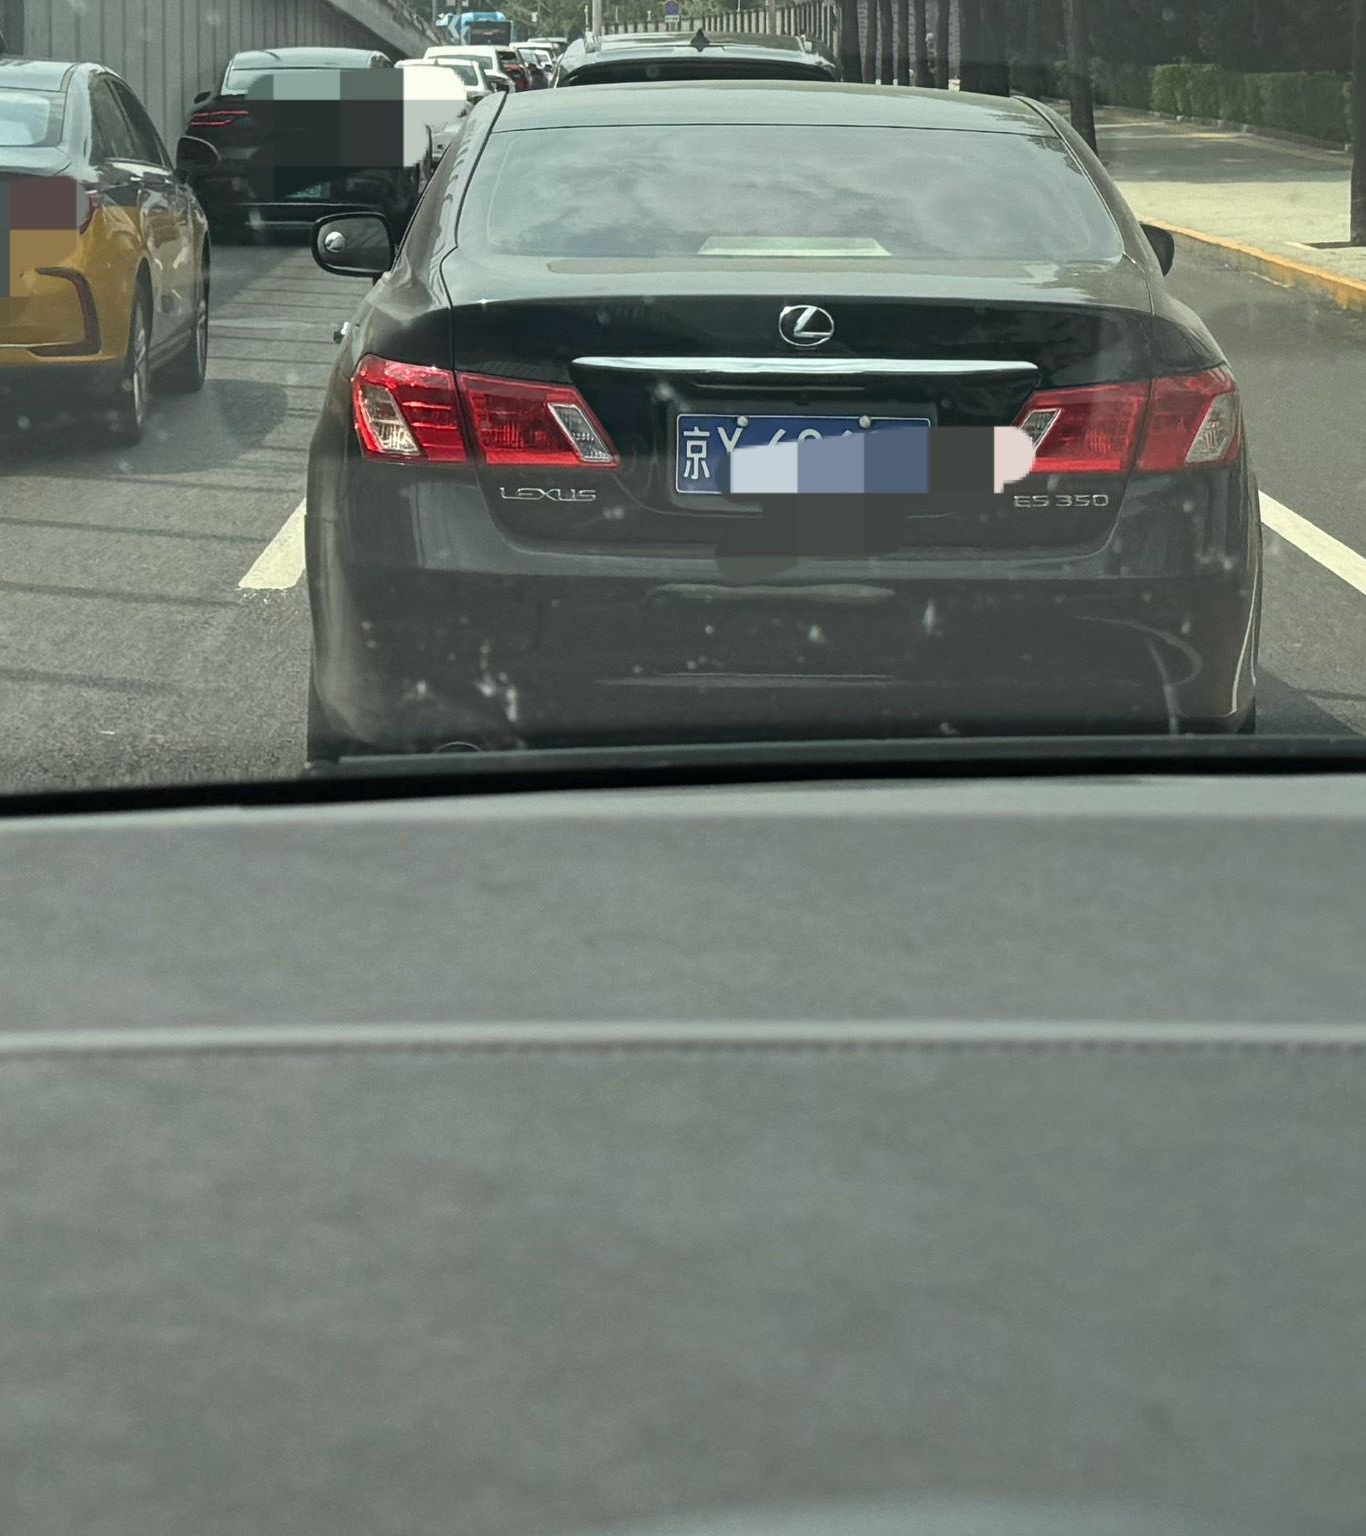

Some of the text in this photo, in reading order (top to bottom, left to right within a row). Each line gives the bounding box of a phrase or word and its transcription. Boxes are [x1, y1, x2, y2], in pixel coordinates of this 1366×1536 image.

[499, 486, 596, 502] LEXUS
[1014, 494, 1109, 508] ES 350
